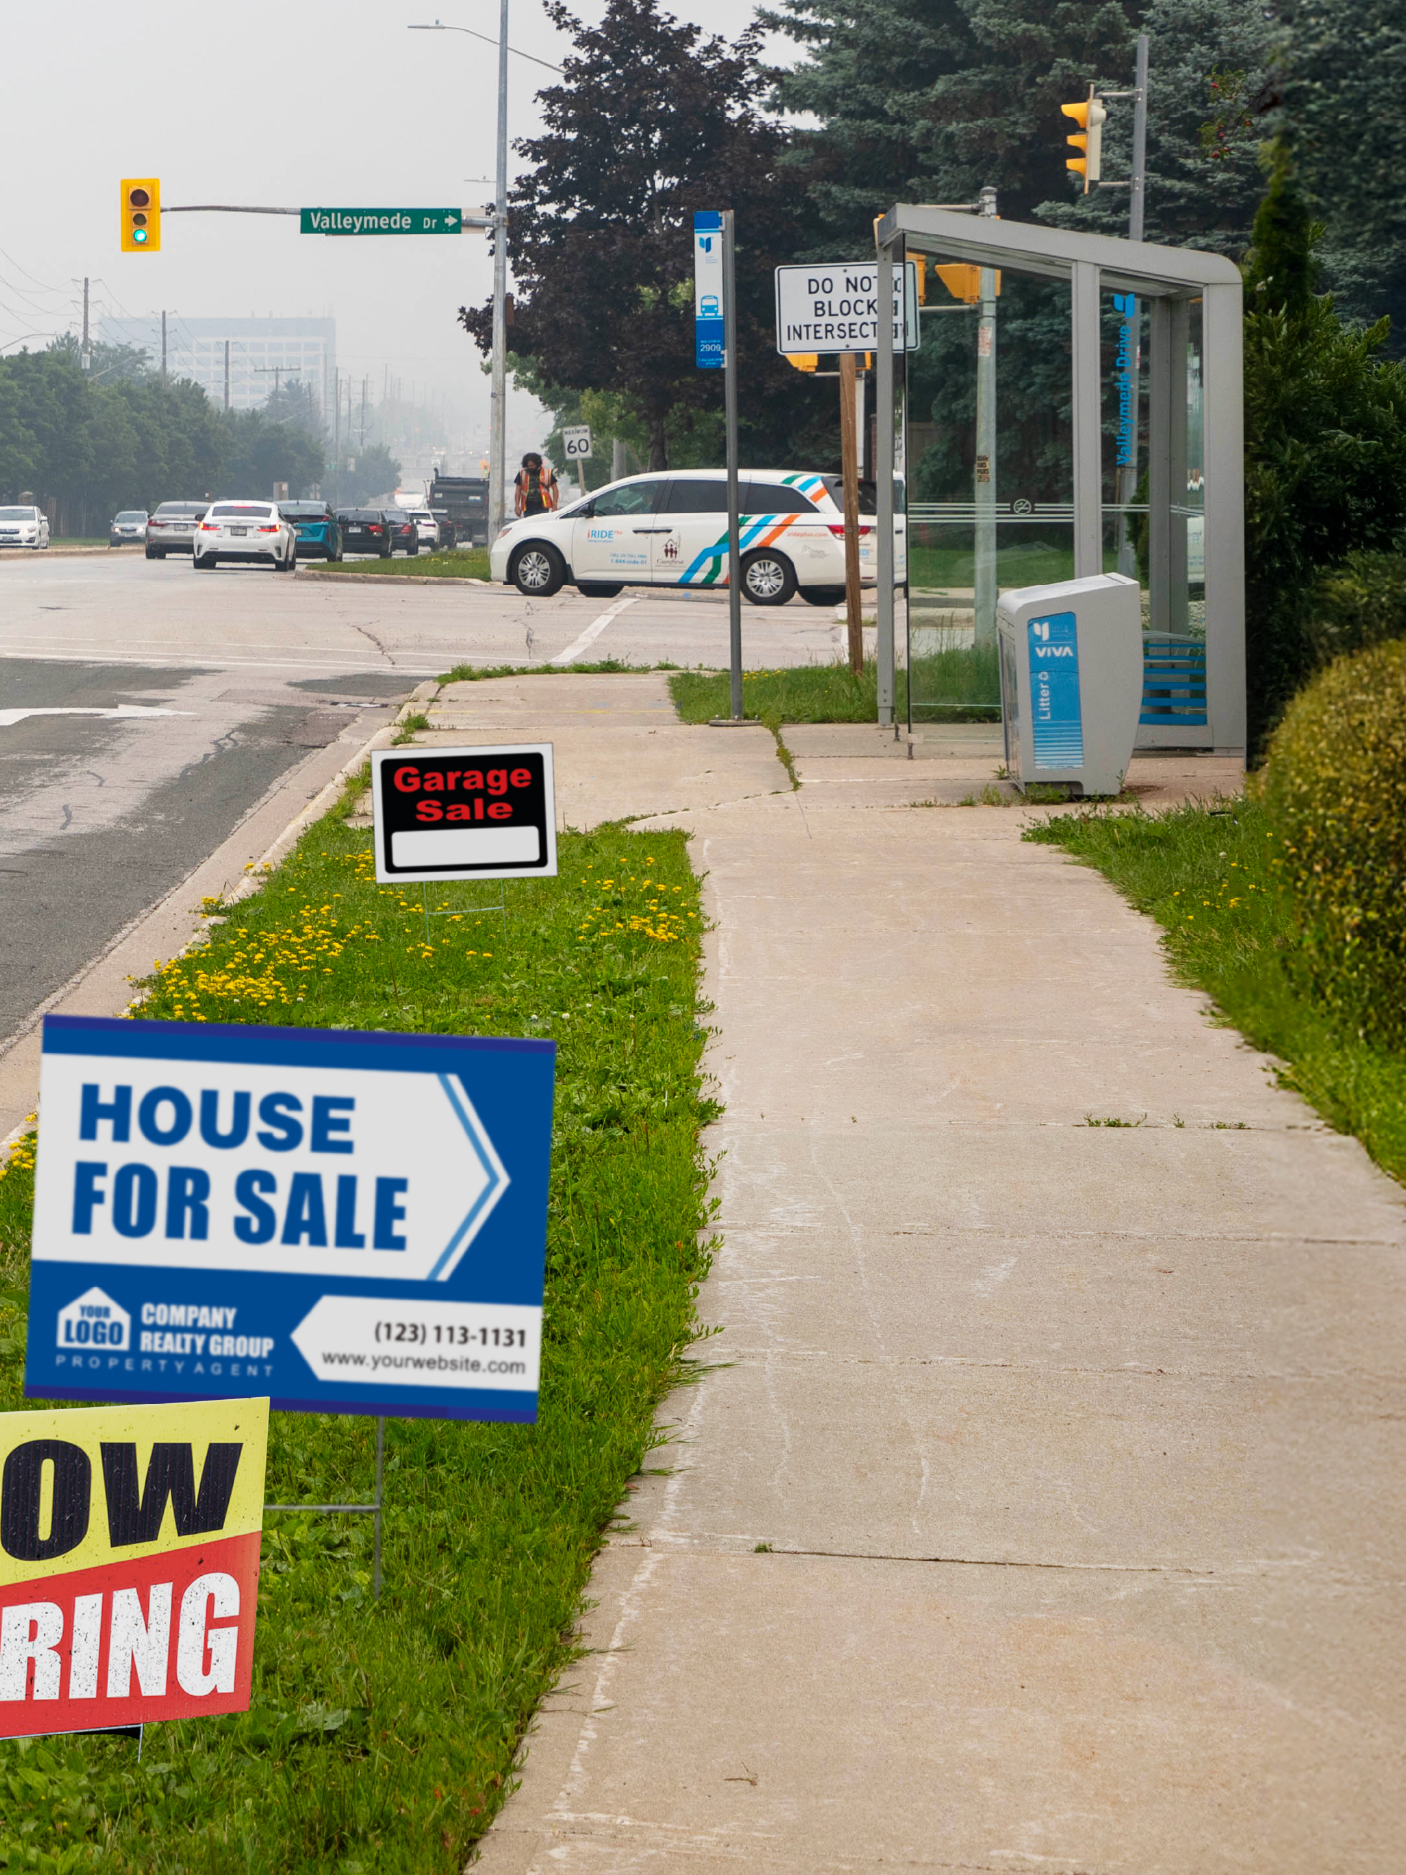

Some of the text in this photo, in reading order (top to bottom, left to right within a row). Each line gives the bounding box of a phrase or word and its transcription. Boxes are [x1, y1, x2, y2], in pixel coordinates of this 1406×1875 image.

[310, 212, 437, 233] Valleymede Dr
[808, 276, 878, 295] DO NO
[814, 299, 878, 317] BLOCK
[787, 321, 909, 341] INTERSECT
[700, 343, 721, 352] 2909
[1115, 325, 1135, 465] Valleymede Drive
[567, 438, 589, 454] 60
[1035, 646, 1074, 658] VIVA
[1038, 683, 1051, 720] Litter
[394, 766, 532, 796] Garage
[415, 798, 513, 822] Sale
[79, 1083, 355, 1154] HOUSE
[71, 1161, 408, 1251] FOR SALE
[79, 1305, 111, 1319] YOUR
[141, 1302, 237, 1329] COMPANY
[64, 1319, 124, 1346] LOGO
[140, 1331, 274, 1358] REALTY GROUP
[375, 1321, 526, 1347] (123) 113-1131
[56, 1354, 274, 1377] PROPERTY AGENT
[322, 1351, 526, 1375] www.yourwebsite.com
